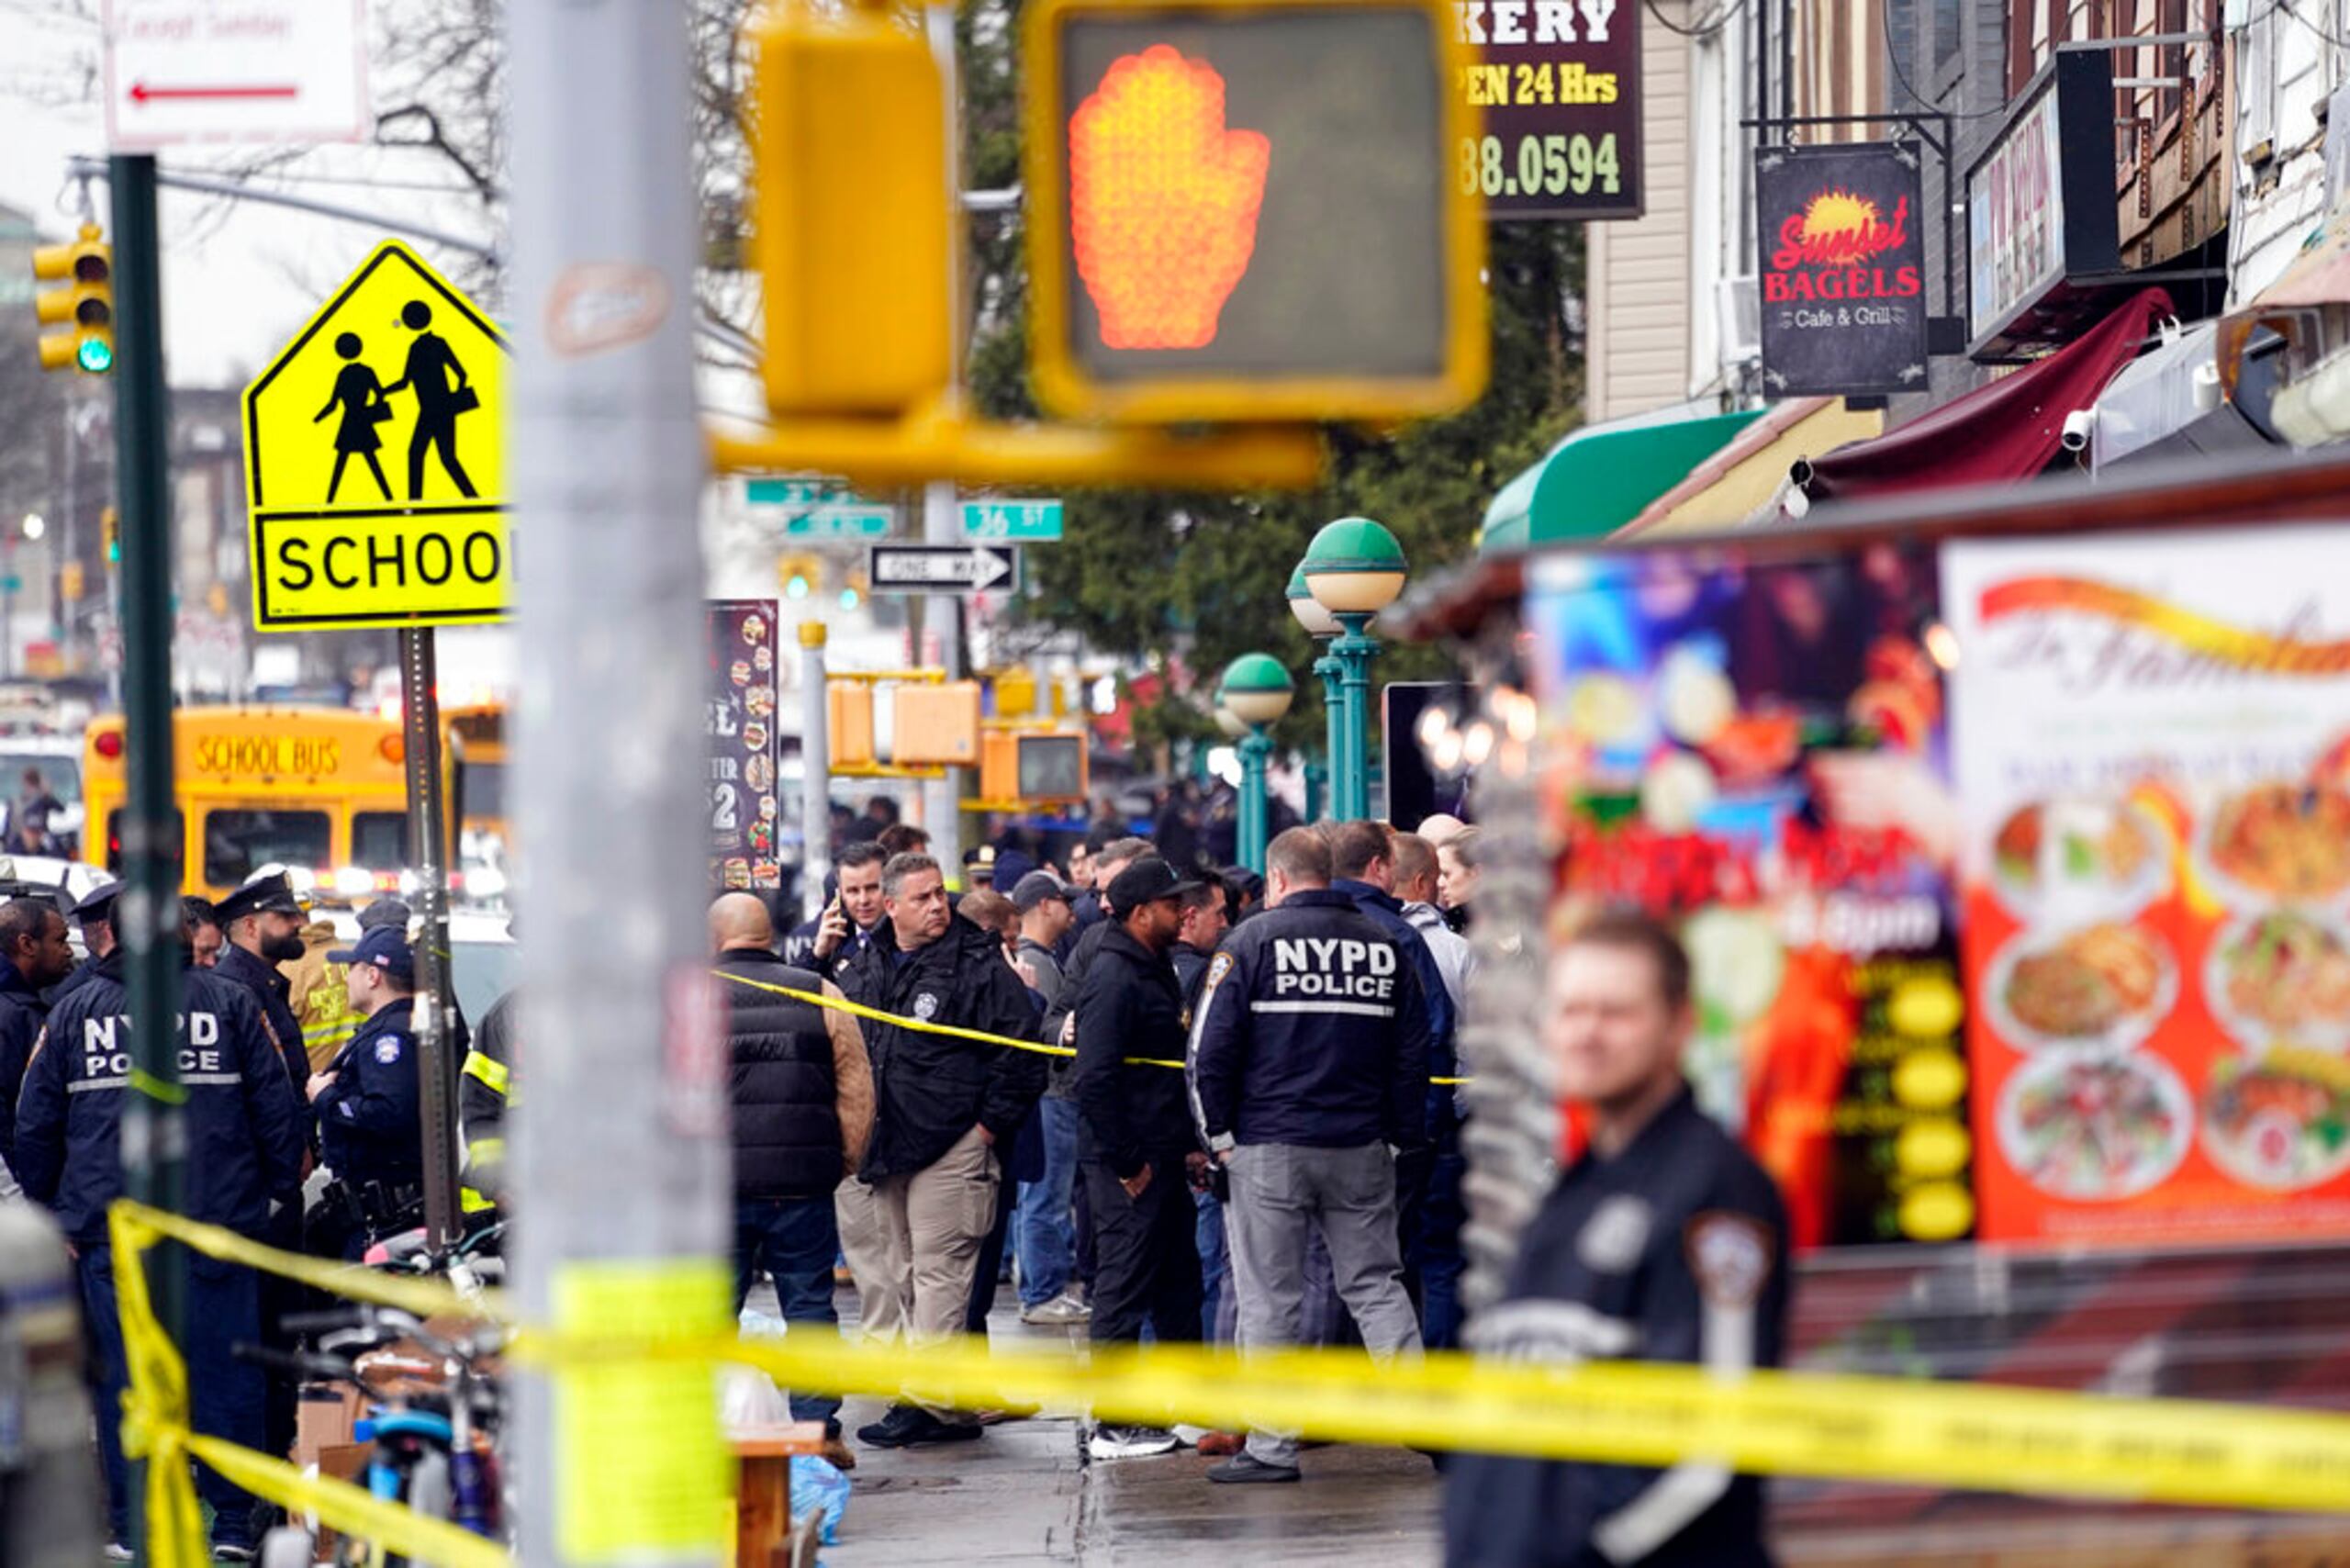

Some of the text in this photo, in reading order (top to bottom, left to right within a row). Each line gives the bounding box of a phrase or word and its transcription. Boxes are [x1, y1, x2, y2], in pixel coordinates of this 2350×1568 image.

[1456, 0, 1617, 44] KERY
[1516, 62, 1555, 105] 24
[1560, 62, 1618, 105] Hrs
[1460, 133, 1620, 196] 88.0594
[1772, 195, 1908, 270] Sunset
[1763, 266, 1921, 302] BAGELS
[1795, 305, 1890, 328] Cafe & Grill
[1021, 507, 1046, 528] ST
[278, 531, 501, 590] SCHOO
[890, 561, 992, 579] ONE WAY
[194, 735, 340, 774] SCHOOL BUS
[1274, 938, 1397, 976] NYPD
[1276, 973, 1394, 998] POLICE
[84, 1012, 219, 1053] ND
[86, 1049, 220, 1077] POCE
